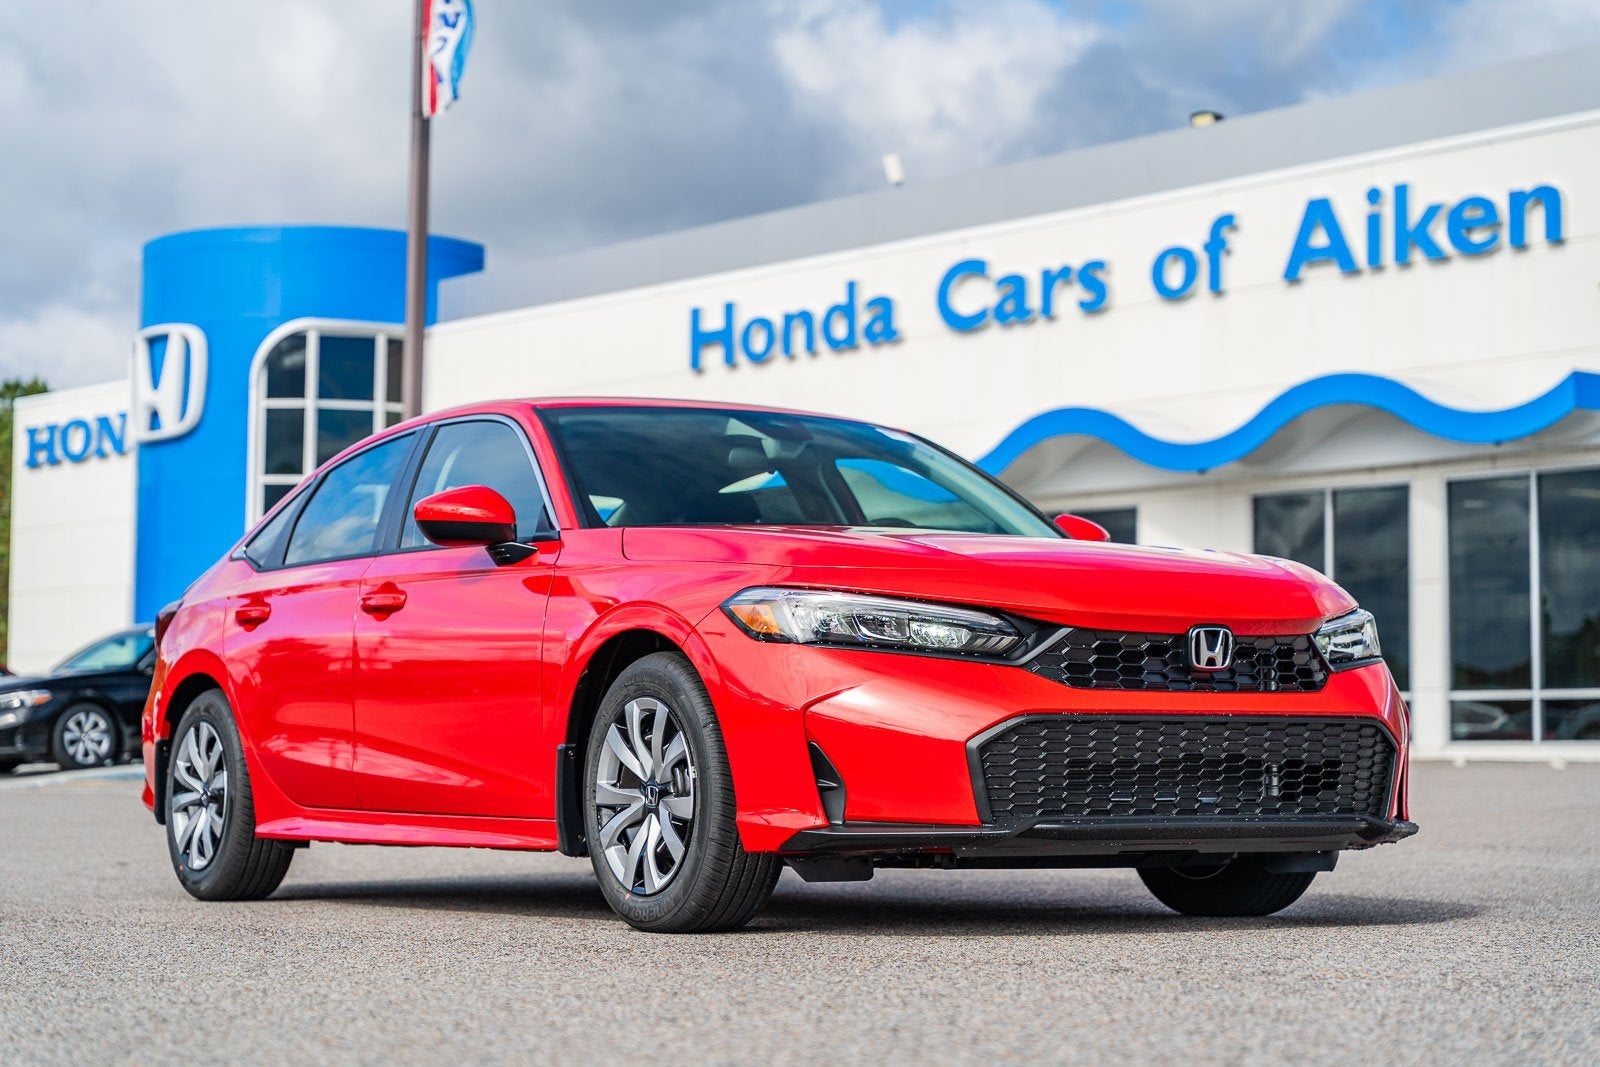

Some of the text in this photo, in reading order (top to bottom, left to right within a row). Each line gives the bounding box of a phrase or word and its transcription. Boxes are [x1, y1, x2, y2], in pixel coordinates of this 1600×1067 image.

[690, 183, 1563, 371] Honda Cars of Aiken
